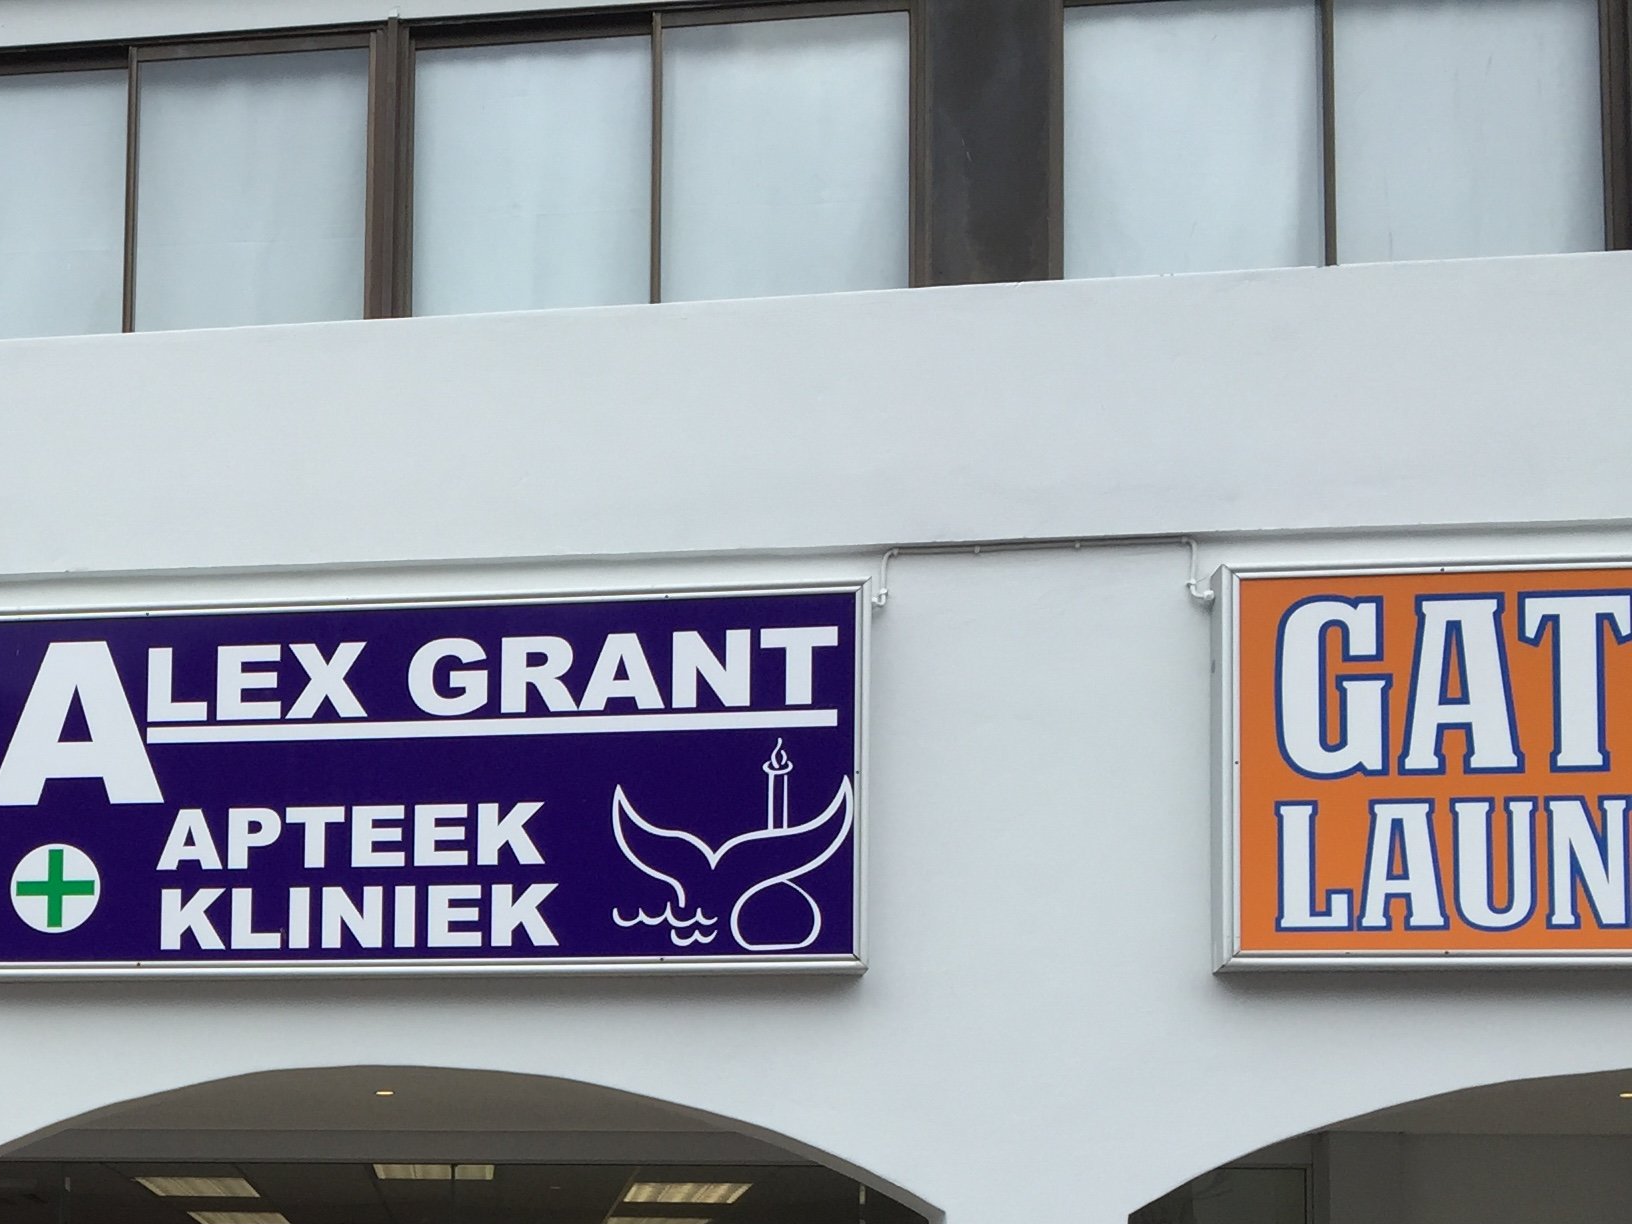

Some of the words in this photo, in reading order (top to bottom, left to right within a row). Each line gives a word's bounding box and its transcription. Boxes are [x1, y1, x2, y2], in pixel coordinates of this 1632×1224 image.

[407, 626, 838, 716] GRANT
[156, 801, 545, 871] APTEEK
[160, 883, 559, 950] KLINIEK
